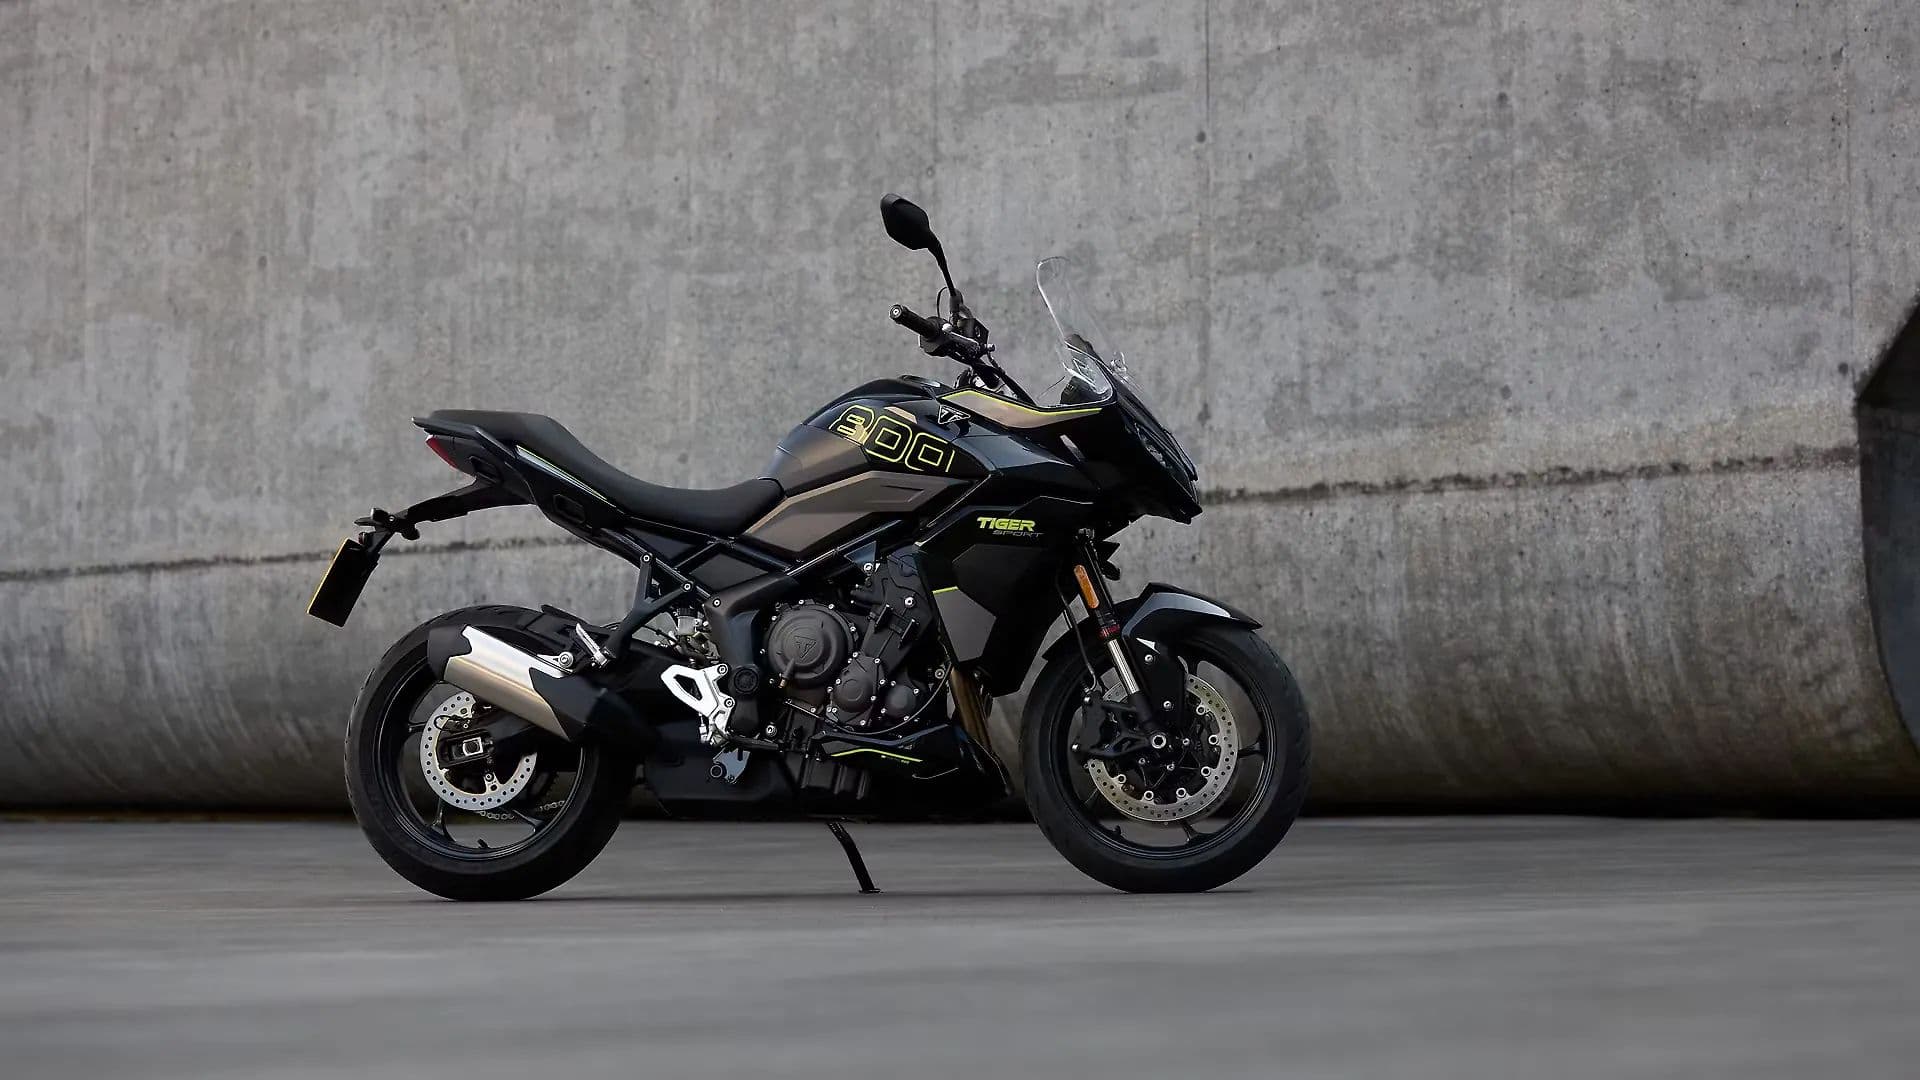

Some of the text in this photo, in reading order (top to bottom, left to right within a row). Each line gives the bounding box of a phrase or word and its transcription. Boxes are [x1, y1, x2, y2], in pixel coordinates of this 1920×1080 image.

[828, 404, 956, 473] 800
[976, 516, 1036, 532] TIGER
[992, 529, 1044, 538] SPORT
